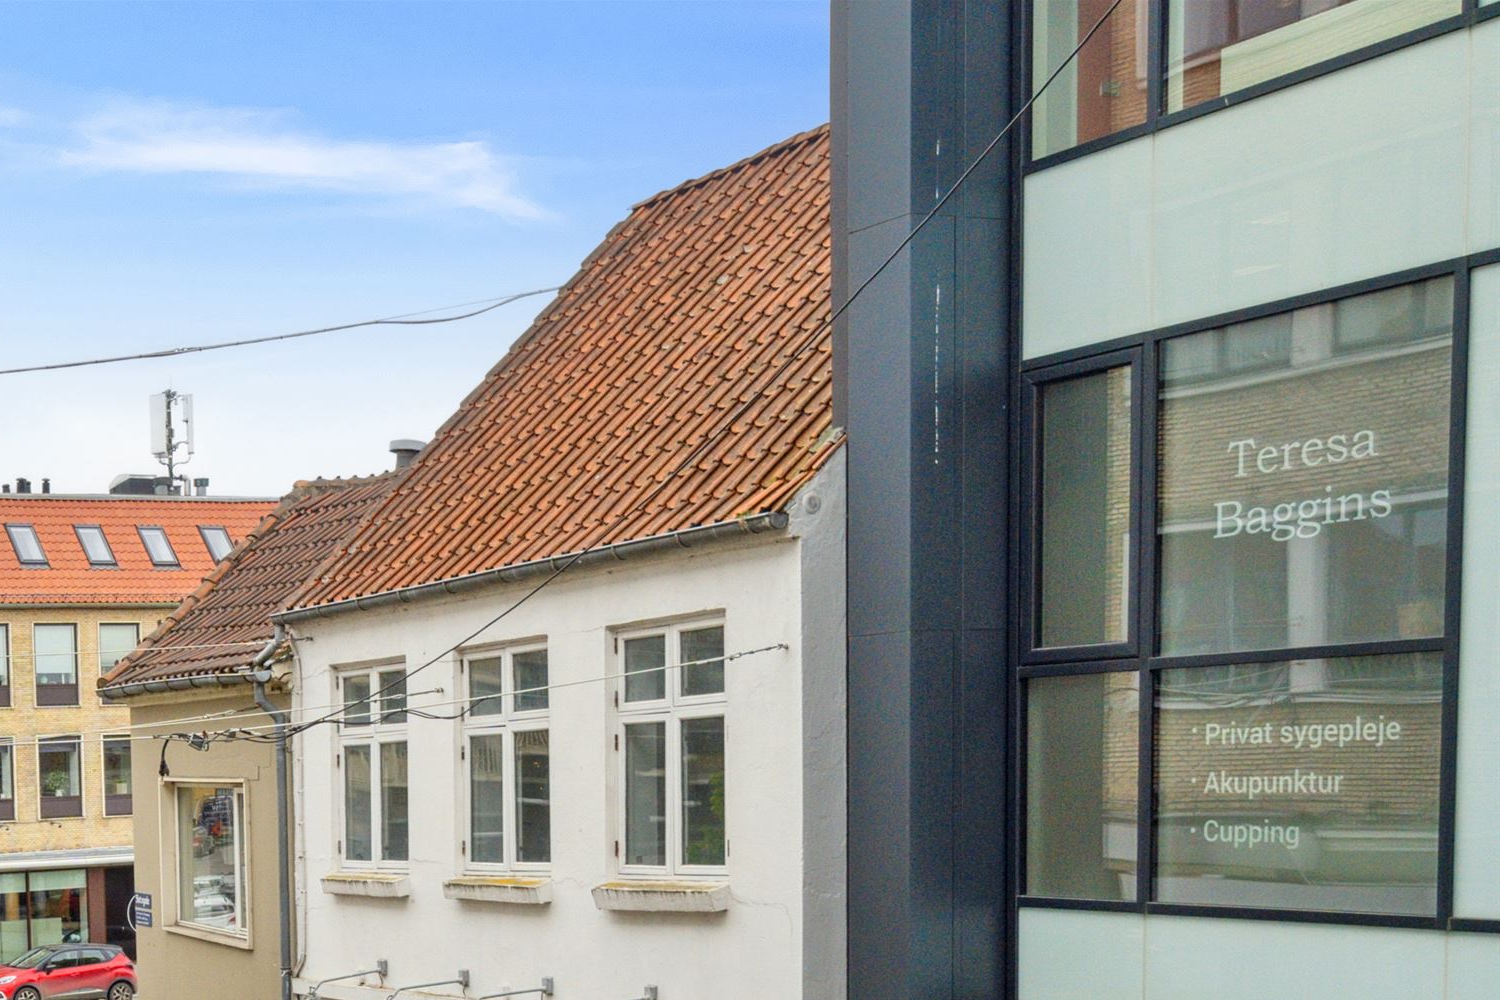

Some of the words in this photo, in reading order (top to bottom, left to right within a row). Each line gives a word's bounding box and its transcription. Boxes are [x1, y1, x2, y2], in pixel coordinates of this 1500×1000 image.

[1227, 429, 1379, 477] Teresa
[1213, 485, 1392, 542] Baggins
[1205, 721, 1273, 746] Privat
[1279, 715, 1402, 750] sygepleje
[1204, 771, 1344, 799] Akupunktur
[1203, 819, 1300, 849] Cupping
